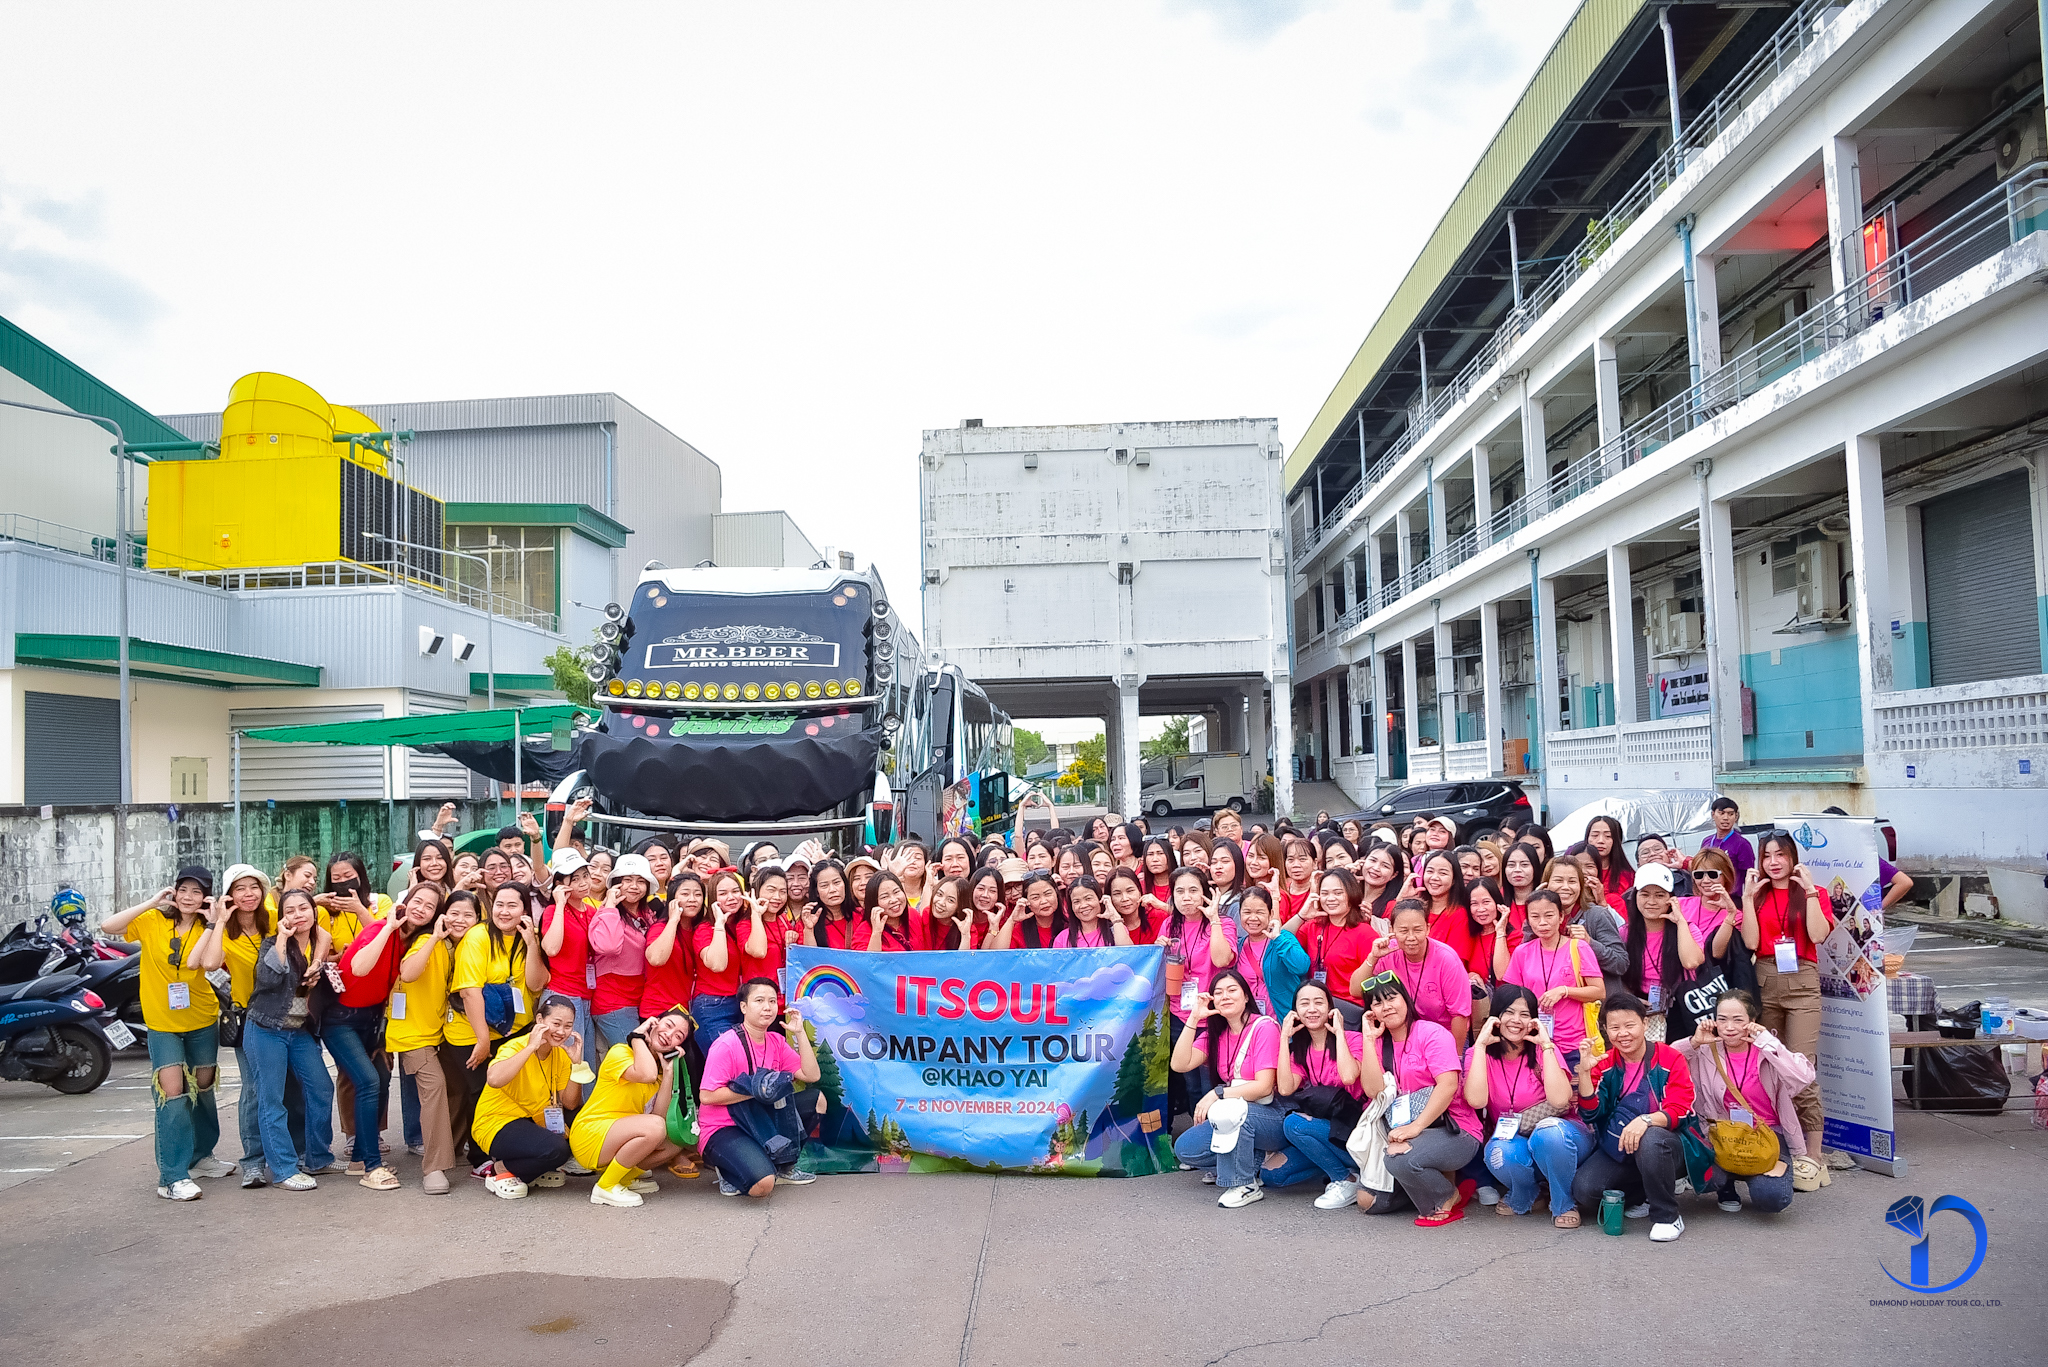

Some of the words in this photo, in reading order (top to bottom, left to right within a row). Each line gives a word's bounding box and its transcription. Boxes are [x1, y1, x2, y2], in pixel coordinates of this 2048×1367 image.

[673, 645, 810, 660] MR.BEER
[731, 660, 794, 668] SERVICE
[1811, 857, 1831, 870] Holiday
[1832, 858, 1844, 868] Tour
[895, 974, 1069, 1026] ITSOUL
[837, 1032, 1012, 1064] COMPANY
[1022, 1033, 1116, 1063] TOUR
[921, 1067, 1005, 1088] @KHAO
[1010, 1068, 1048, 1088] YAI
[896, 1099, 905, 1112] 7
[918, 1100, 928, 1112] 8
[931, 1100, 1012, 1114] NOVEMBER
[1017, 1101, 1056, 1115] 2024
